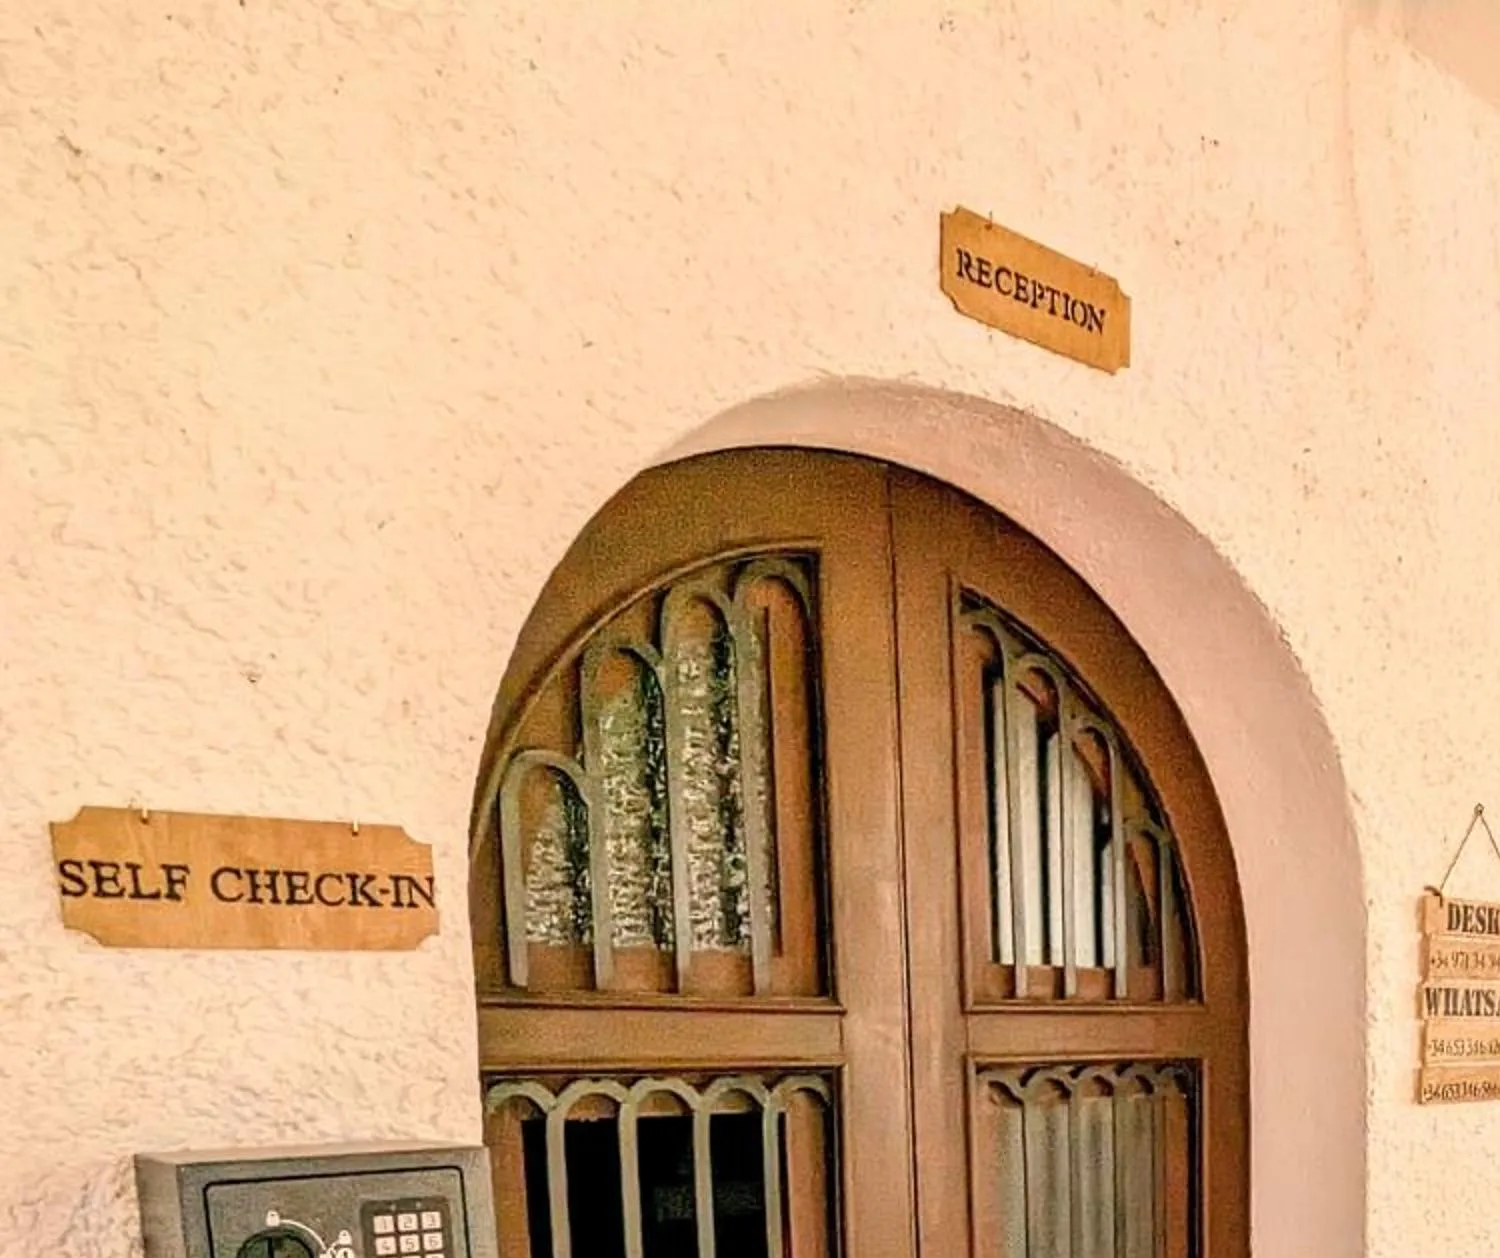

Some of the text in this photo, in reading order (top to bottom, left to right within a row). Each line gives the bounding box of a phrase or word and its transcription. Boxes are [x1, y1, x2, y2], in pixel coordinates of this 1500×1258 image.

[956, 247, 1106, 335] RECEPTION
[58, 859, 437, 909] SELF CHECK-IN
[1446, 902, 1500, 935] DESK
